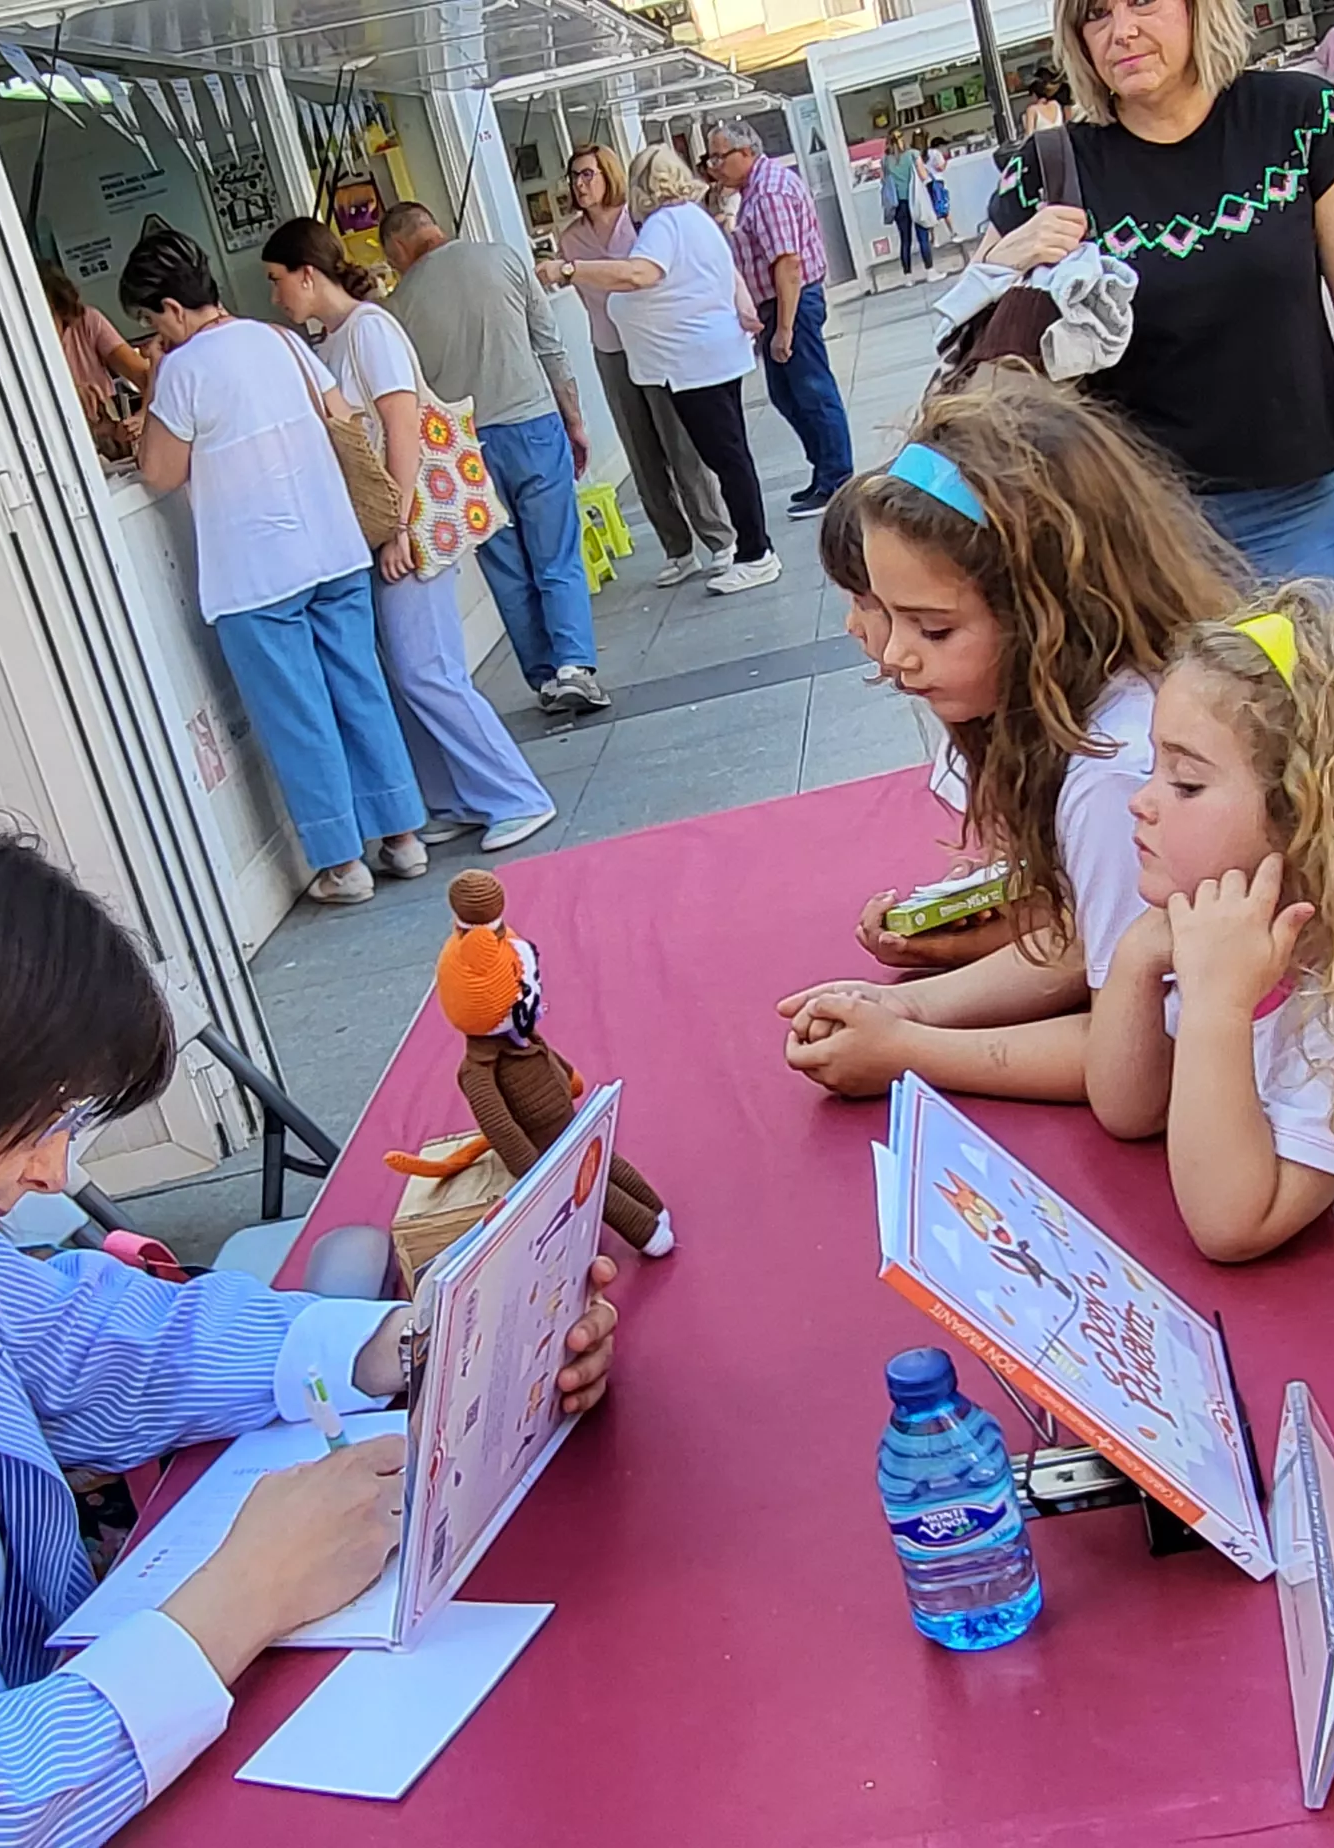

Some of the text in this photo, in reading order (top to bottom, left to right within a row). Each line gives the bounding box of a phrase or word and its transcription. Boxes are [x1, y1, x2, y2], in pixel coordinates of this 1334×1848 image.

[1070, 1272, 1128, 1370] DON
[985, 1345, 1020, 1376] DON
[921, 1507, 965, 1523] MONTE
[929, 1517, 970, 1531] PINOS
